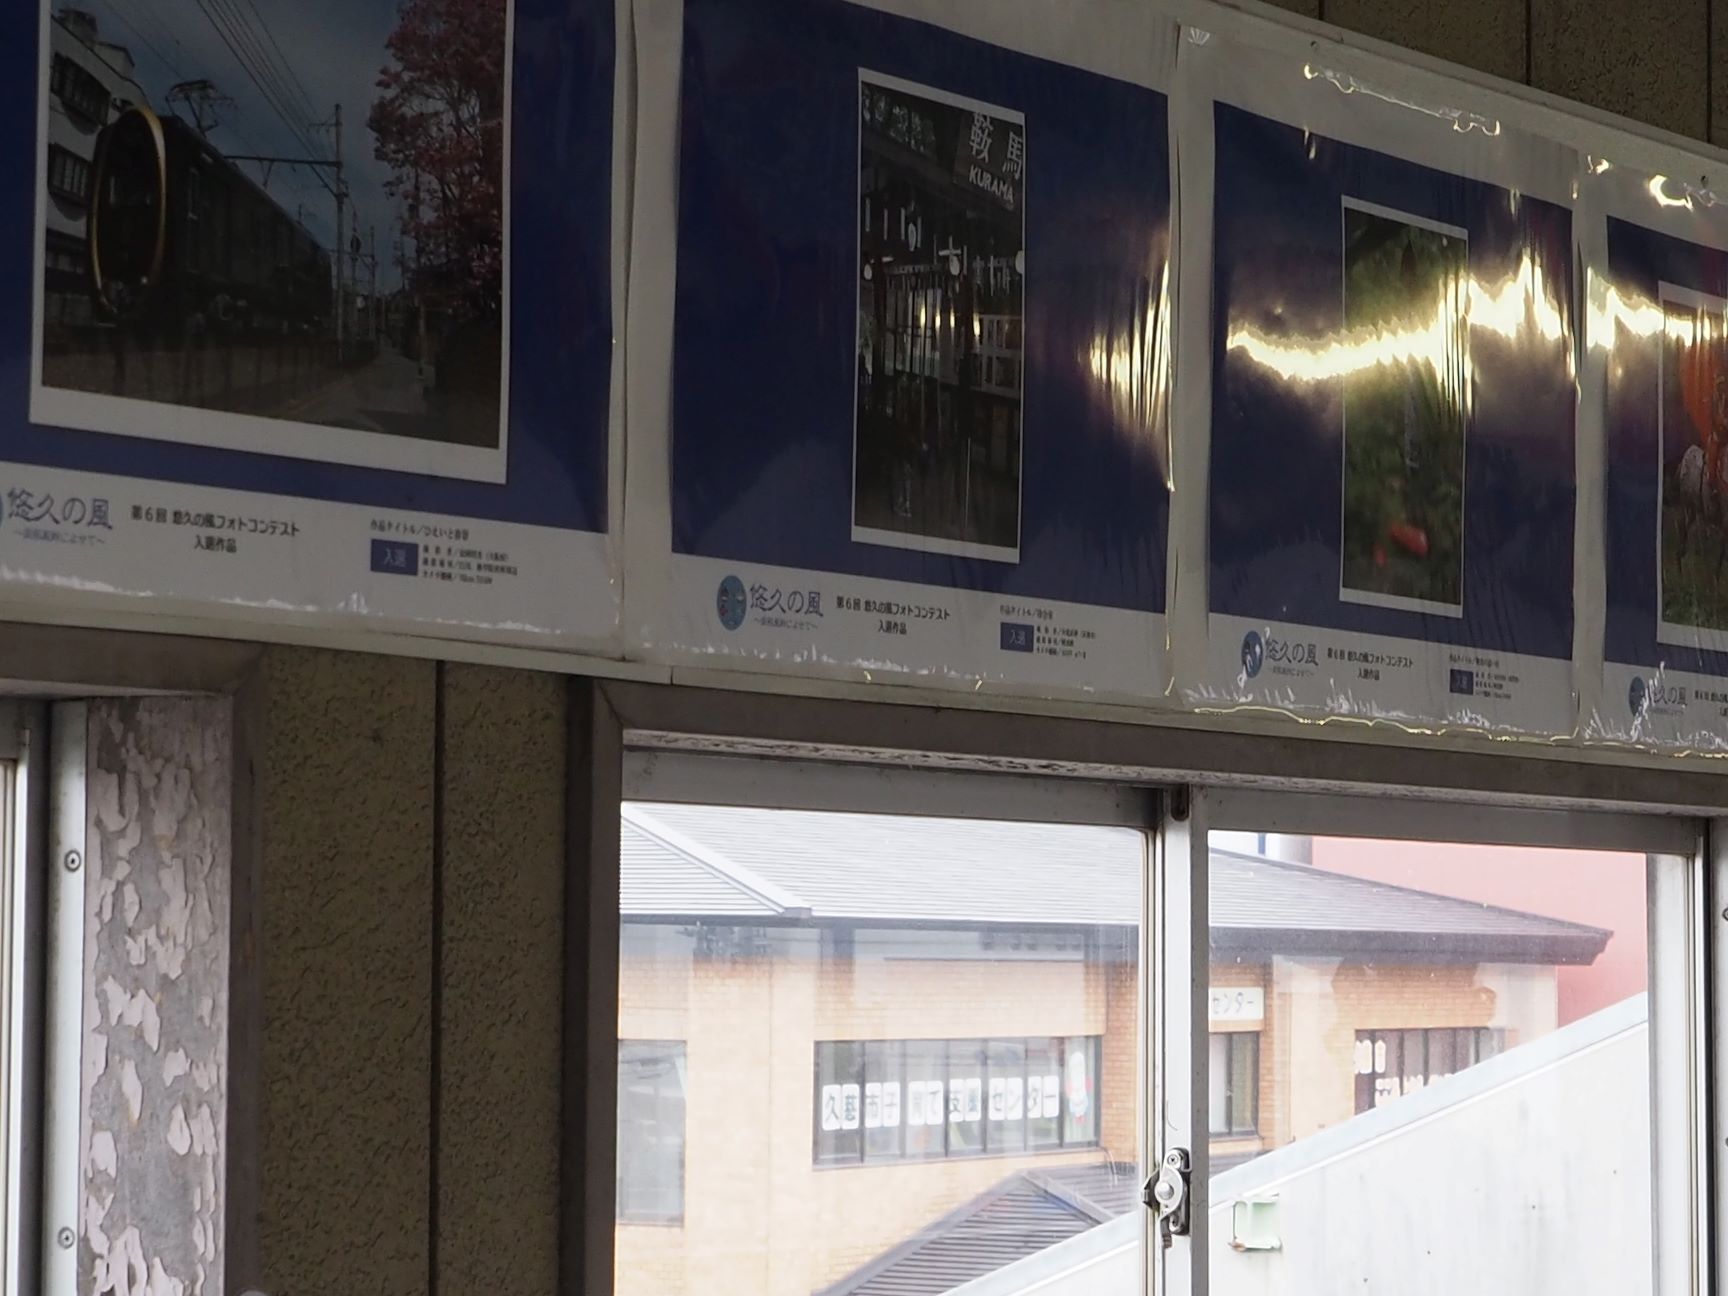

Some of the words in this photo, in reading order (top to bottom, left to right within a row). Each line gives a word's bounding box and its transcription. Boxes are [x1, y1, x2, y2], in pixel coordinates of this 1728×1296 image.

[7, 487, 115, 532] 悠久の風
[749, 582, 825, 619] 悠久の風
